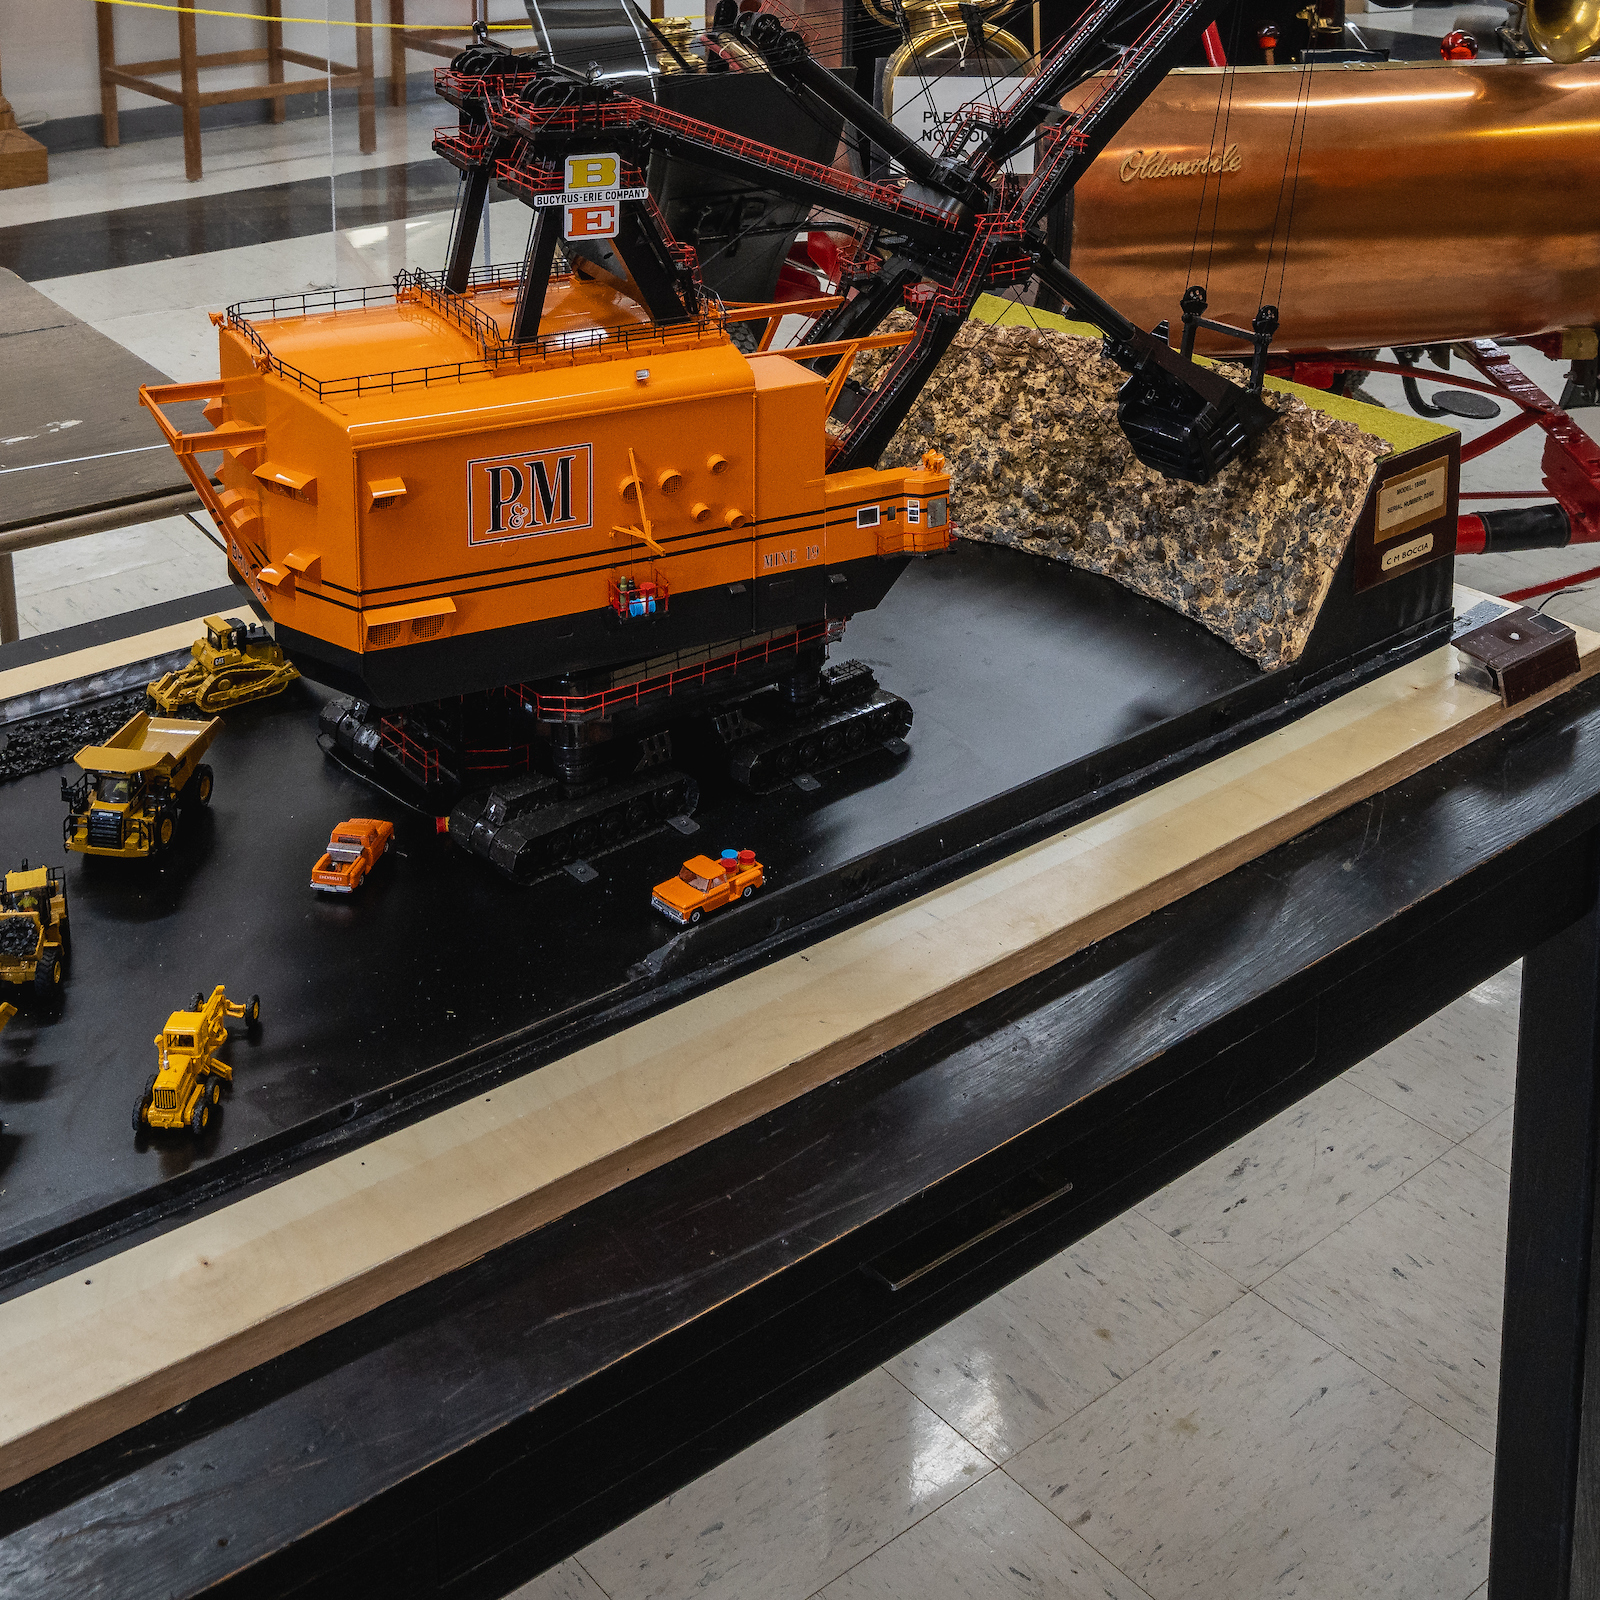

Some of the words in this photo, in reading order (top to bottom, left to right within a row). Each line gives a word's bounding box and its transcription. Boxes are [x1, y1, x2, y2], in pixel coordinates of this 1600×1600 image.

[568, 158, 616, 189] B
[1119, 142, 1242, 182] Oldsmobile
[537, 191, 603, 206] BUCYRUS-ERIE
[605, 188, 647, 200] COMPANY
[568, 205, 615, 237] E
[484, 454, 577, 534] P&M
[763, 549, 797, 569] MINE
[805, 545, 820, 560] 19
[1393, 555, 1400, 563] M
[1401, 542, 1429, 559] BOCCIA
[214, 657, 225, 666] CAT
